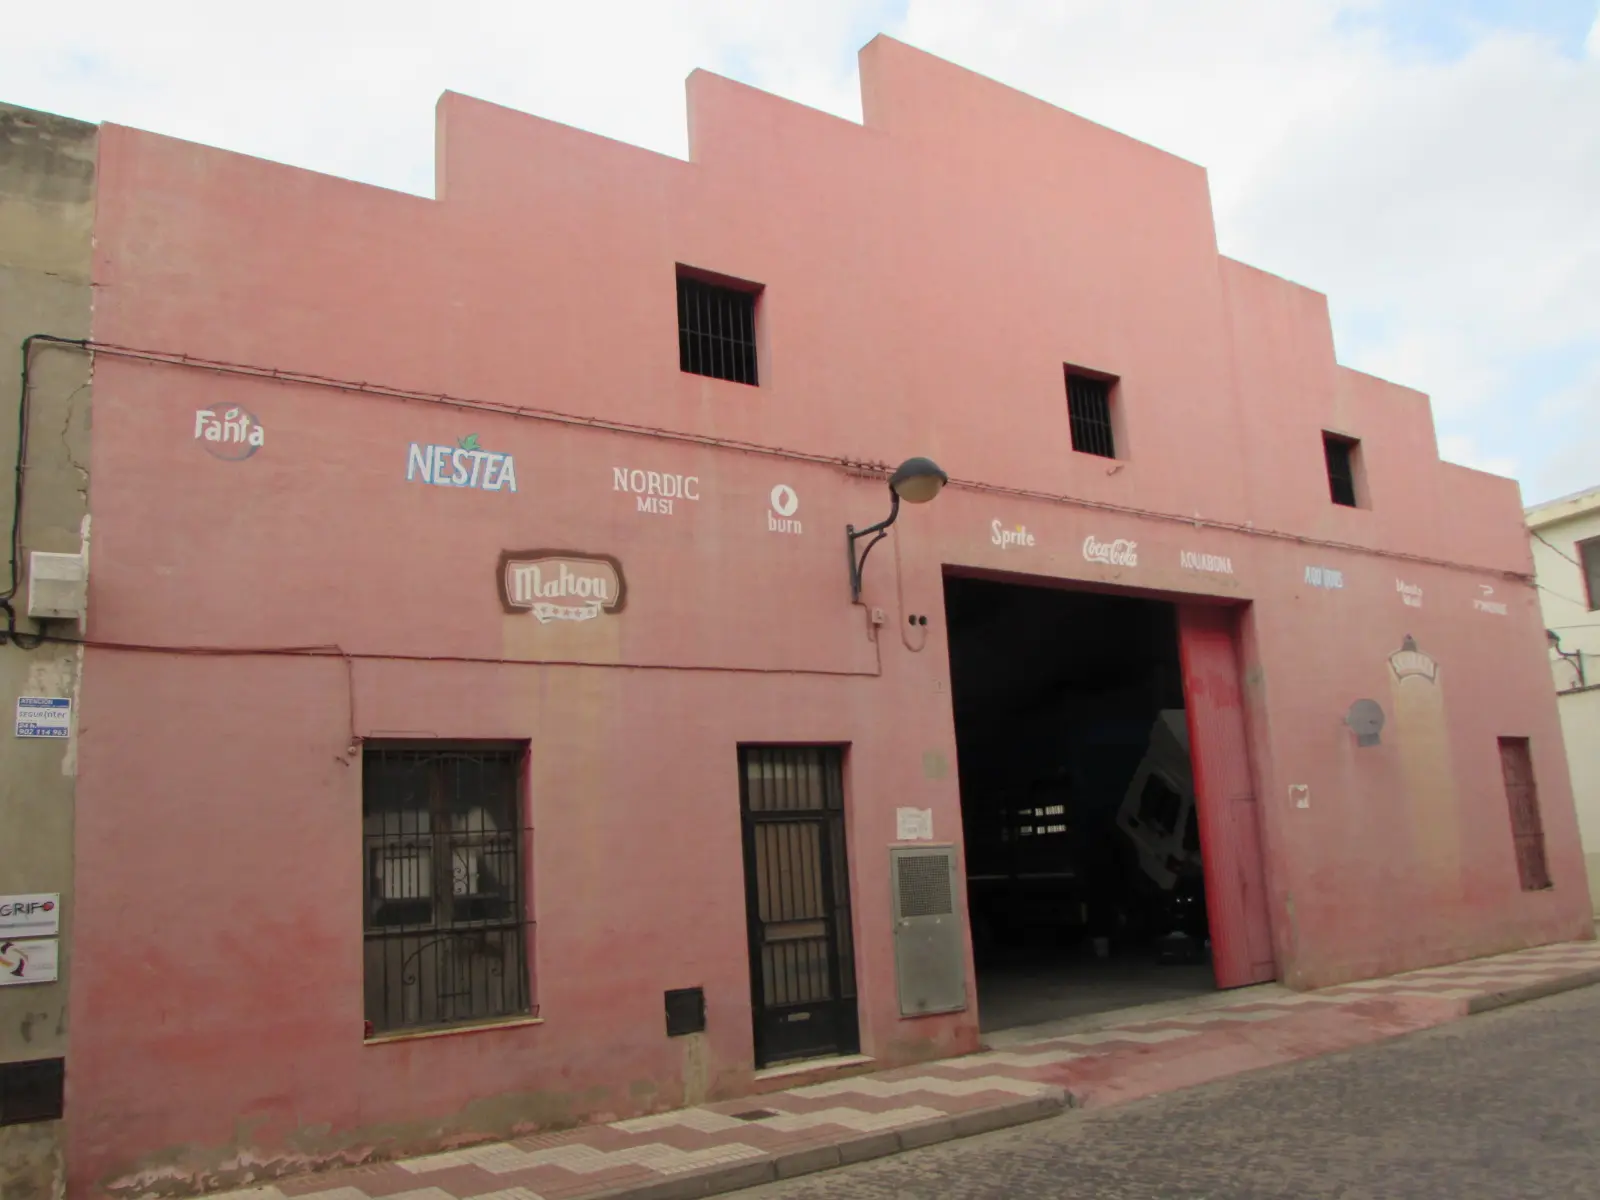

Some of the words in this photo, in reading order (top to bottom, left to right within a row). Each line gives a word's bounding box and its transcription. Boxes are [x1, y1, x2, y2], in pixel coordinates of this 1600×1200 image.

[195, 408, 264, 447] Fanta
[406, 443, 518, 492] NESTEA
[613, 467, 700, 501] NORDIC
[768, 510, 803, 534] burn
[991, 518, 1036, 549] Sprite
[512, 563, 609, 601] Mahou
